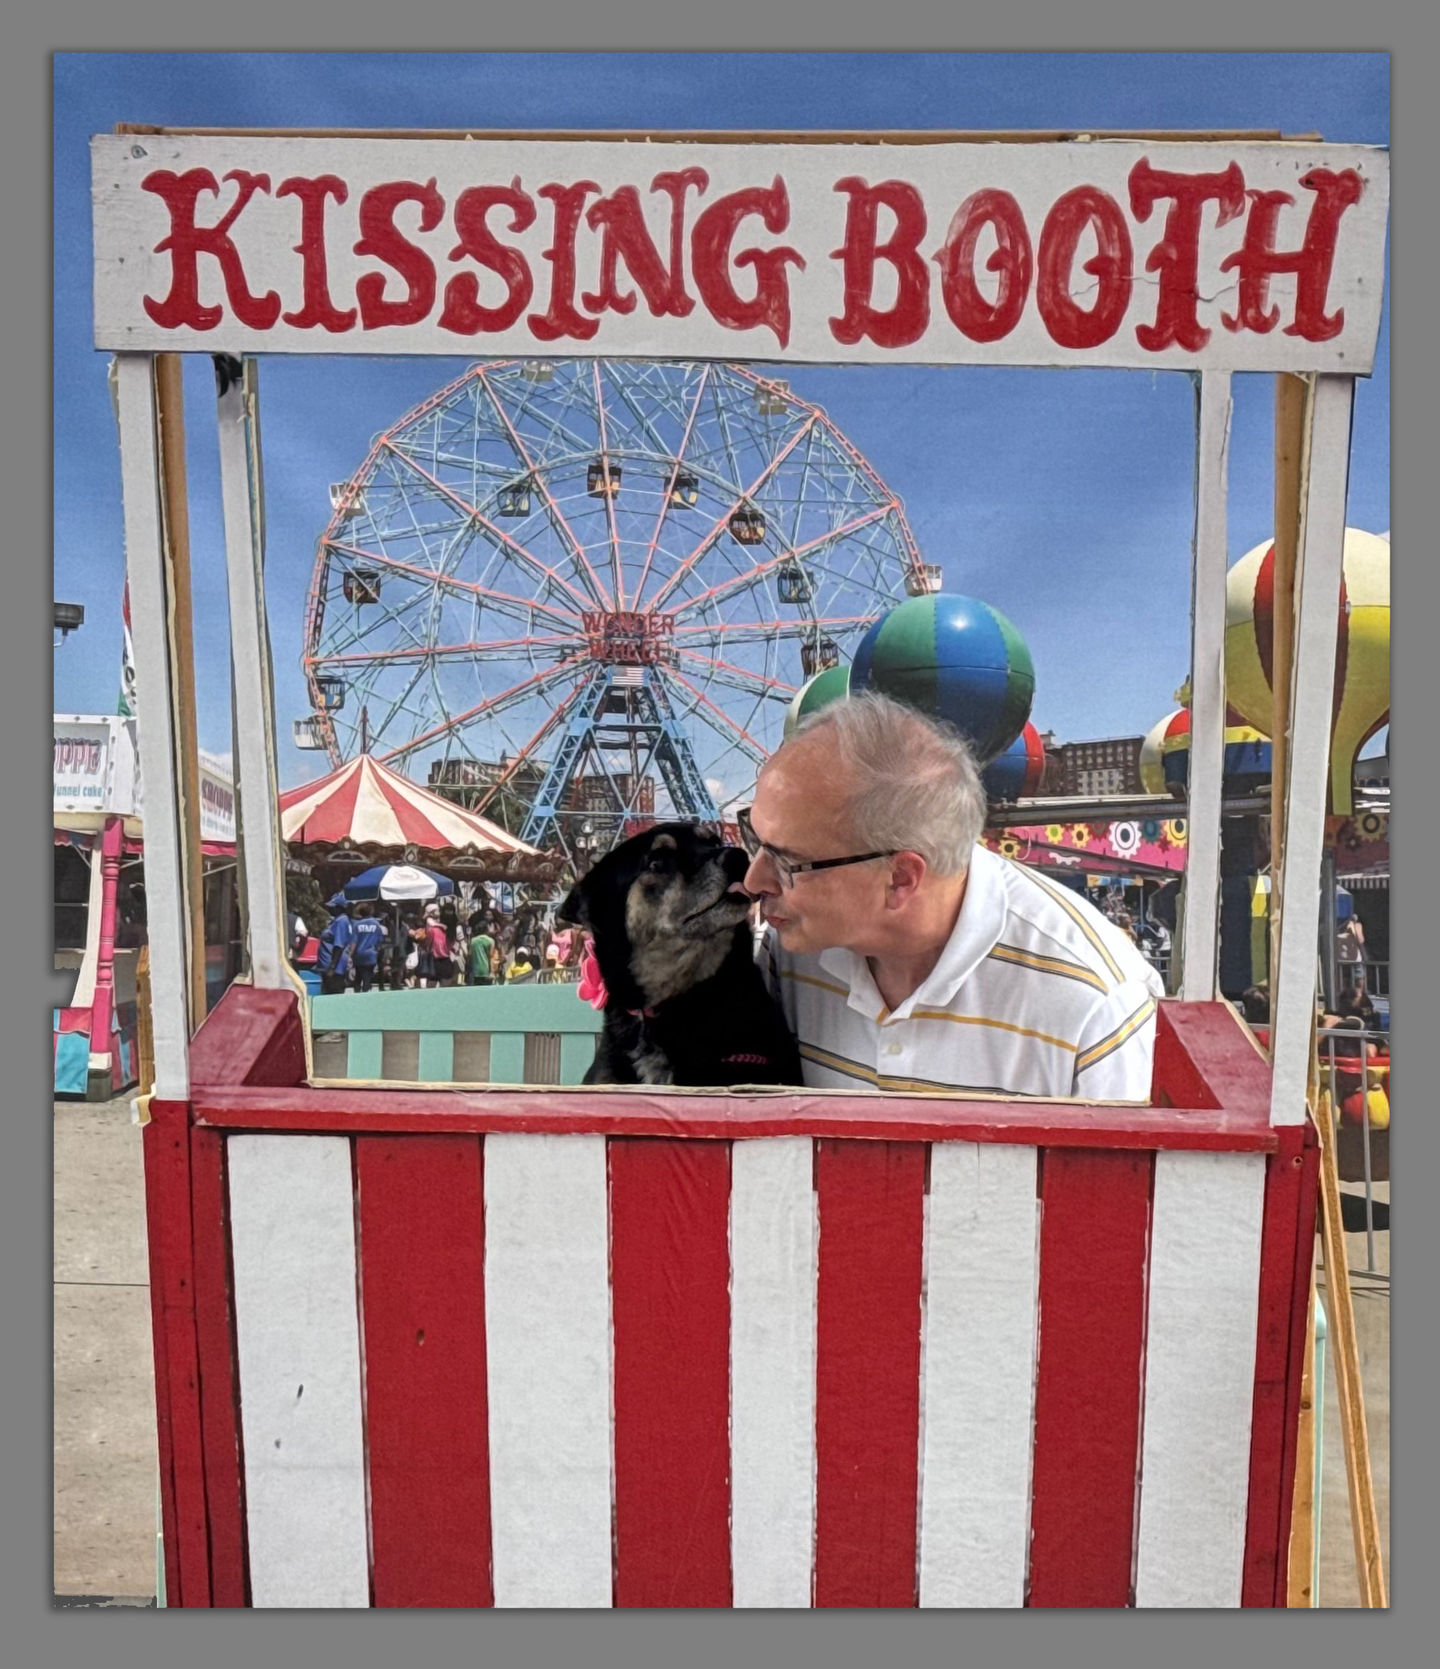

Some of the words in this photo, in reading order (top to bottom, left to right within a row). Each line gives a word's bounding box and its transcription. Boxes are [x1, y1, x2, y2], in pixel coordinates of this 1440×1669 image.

[141, 166, 806, 350] KISSING
[828, 156, 1364, 352] BOOTH
[582, 612, 675, 636] WONDER
[357, 924, 377, 933] STAFF
